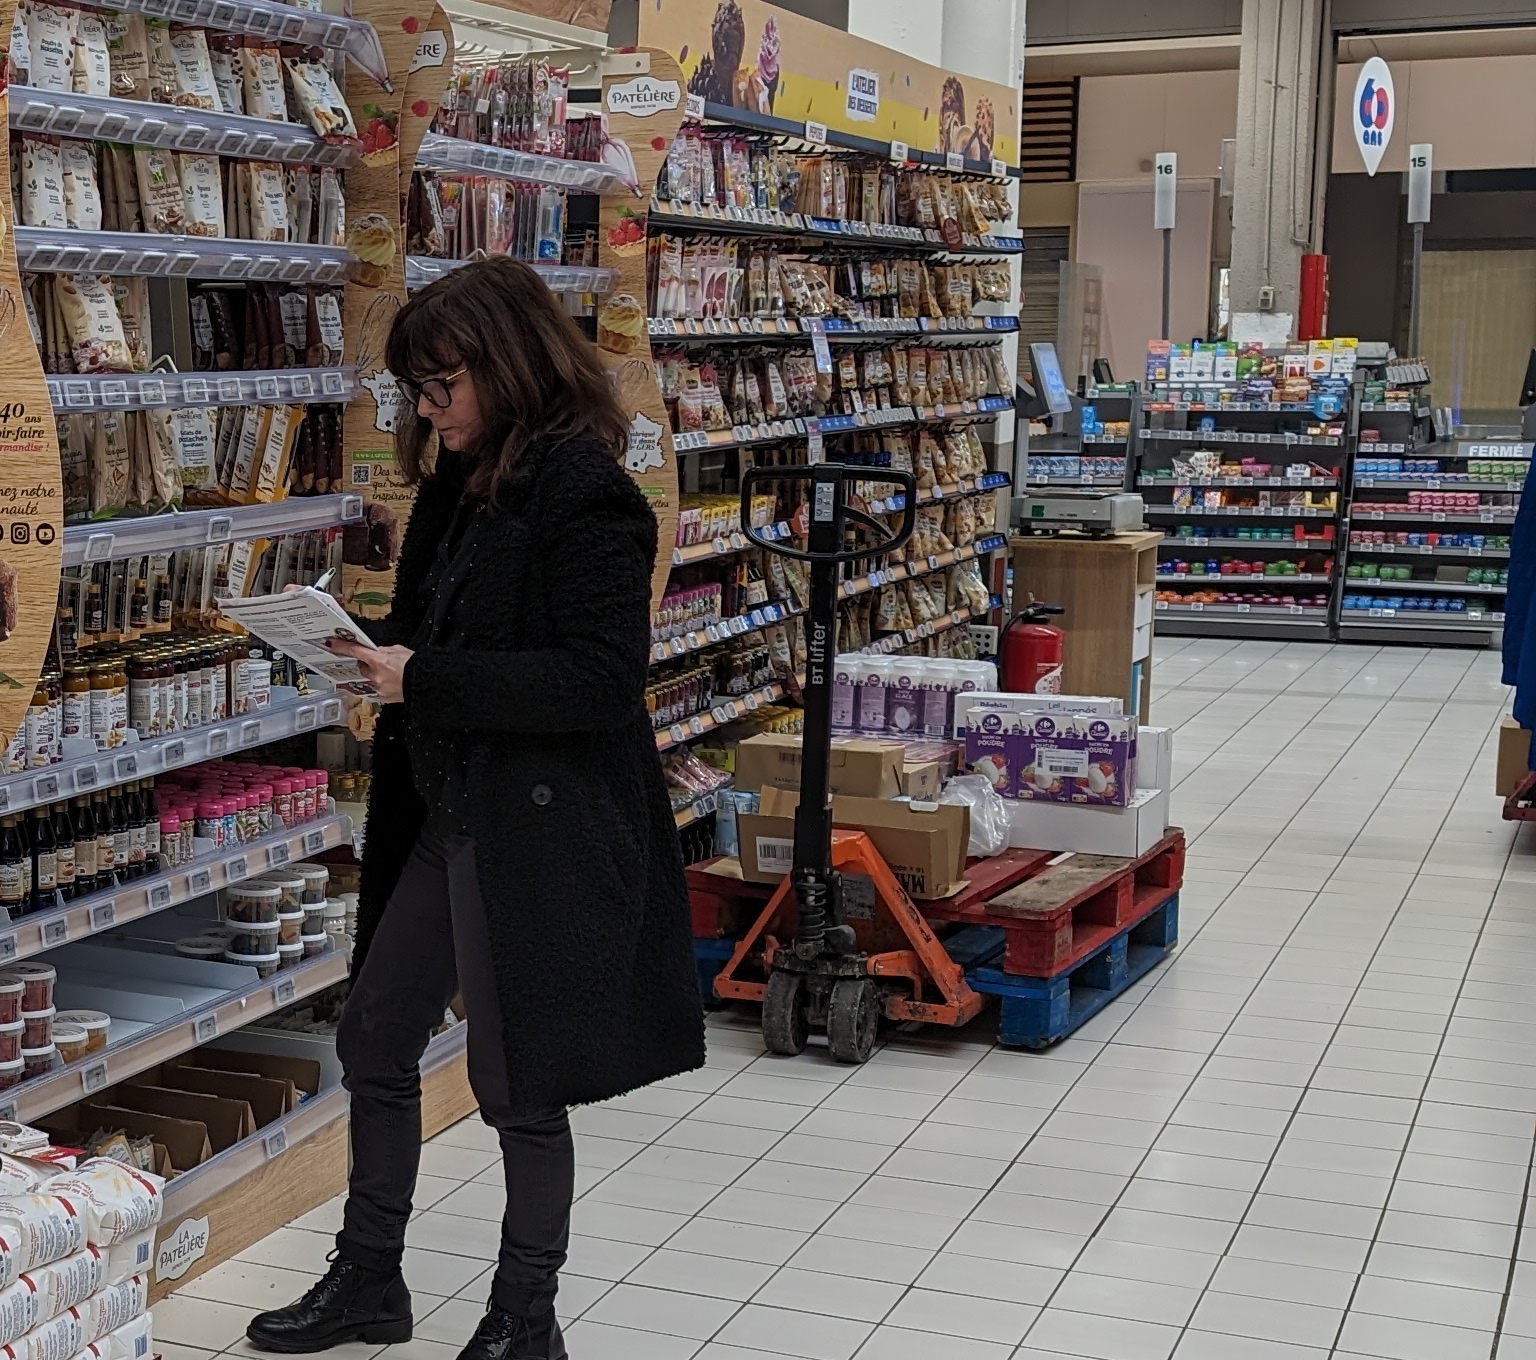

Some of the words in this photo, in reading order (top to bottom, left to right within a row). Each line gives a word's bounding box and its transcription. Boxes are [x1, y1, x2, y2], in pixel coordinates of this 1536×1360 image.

[636, 83, 651, 92] LA
[613, 89, 681, 106] PATELIÈRE
[1411, 156, 1427, 168] 15
[1157, 164, 1173, 175] 16
[1469, 443, 1524, 457] FERMÉ
[21, 483, 56, 498] notre
[812, 665, 824, 685] BT
